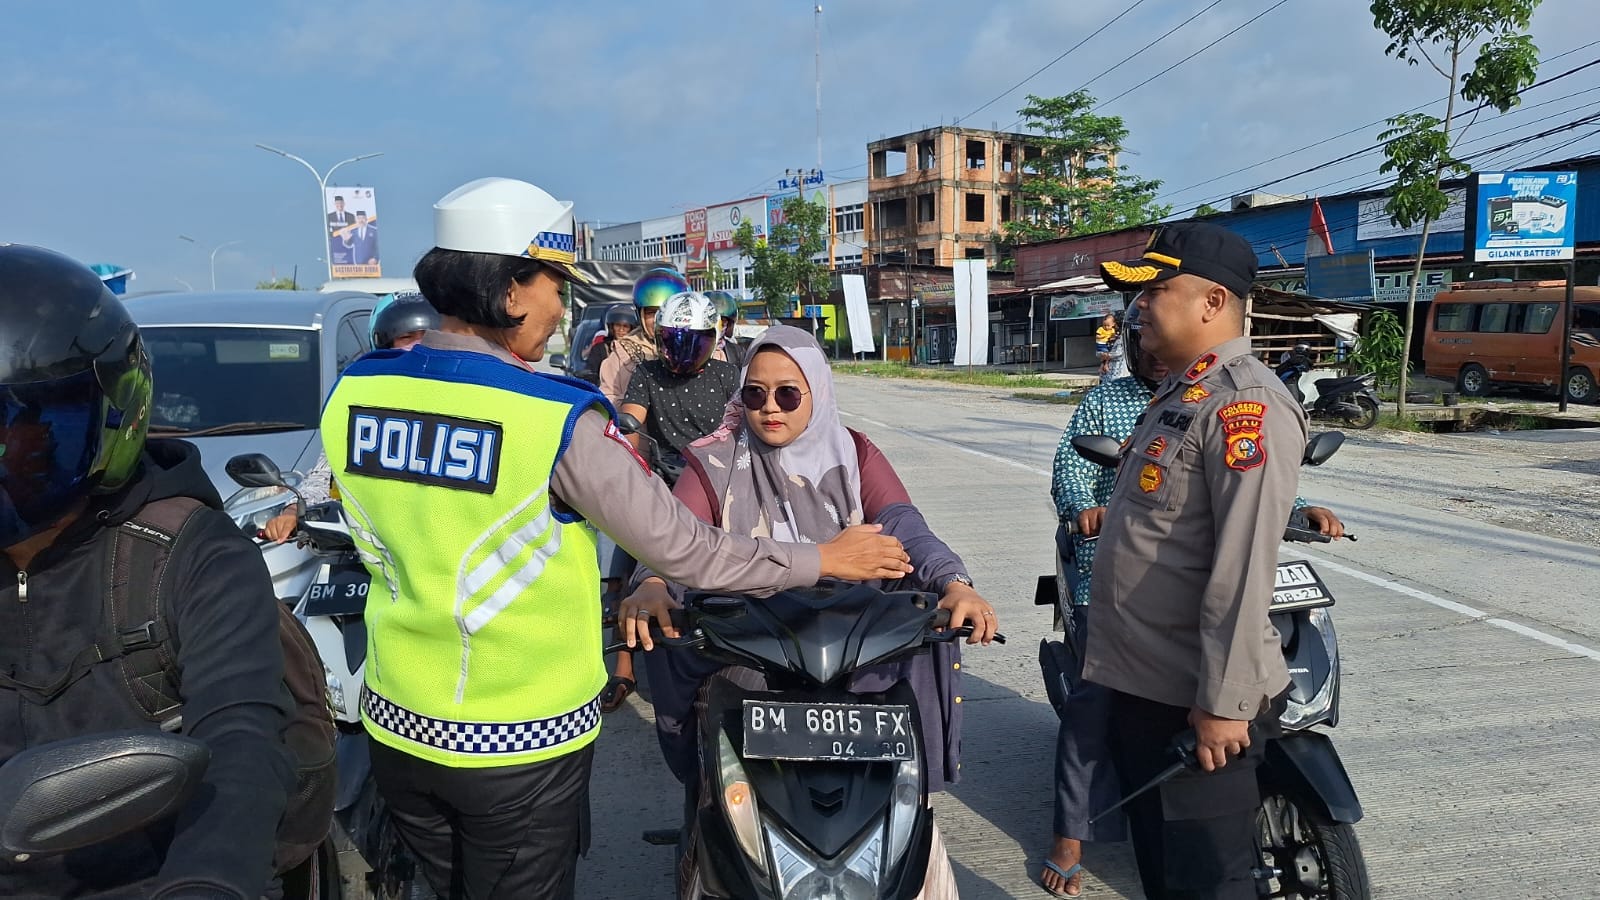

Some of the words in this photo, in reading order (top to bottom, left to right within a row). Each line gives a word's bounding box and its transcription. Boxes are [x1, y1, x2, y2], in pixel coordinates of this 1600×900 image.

[685, 211, 705, 223] TOKO
[691, 221, 705, 232] CAT
[1488, 250, 1522, 258] GILANK
[1523, 249, 1562, 258] BATTERY
[1222, 402, 1263, 416] POLRESTA
[1228, 420, 1259, 430] RIAU
[353, 414, 497, 484] POLISI
[1276, 566, 1309, 584] ZAT
[310, 584, 337, 599] BM
[751, 706, 787, 732] BM
[806, 709, 862, 733] 6815
[875, 711, 906, 736] FX
[832, 741, 856, 756] 04
